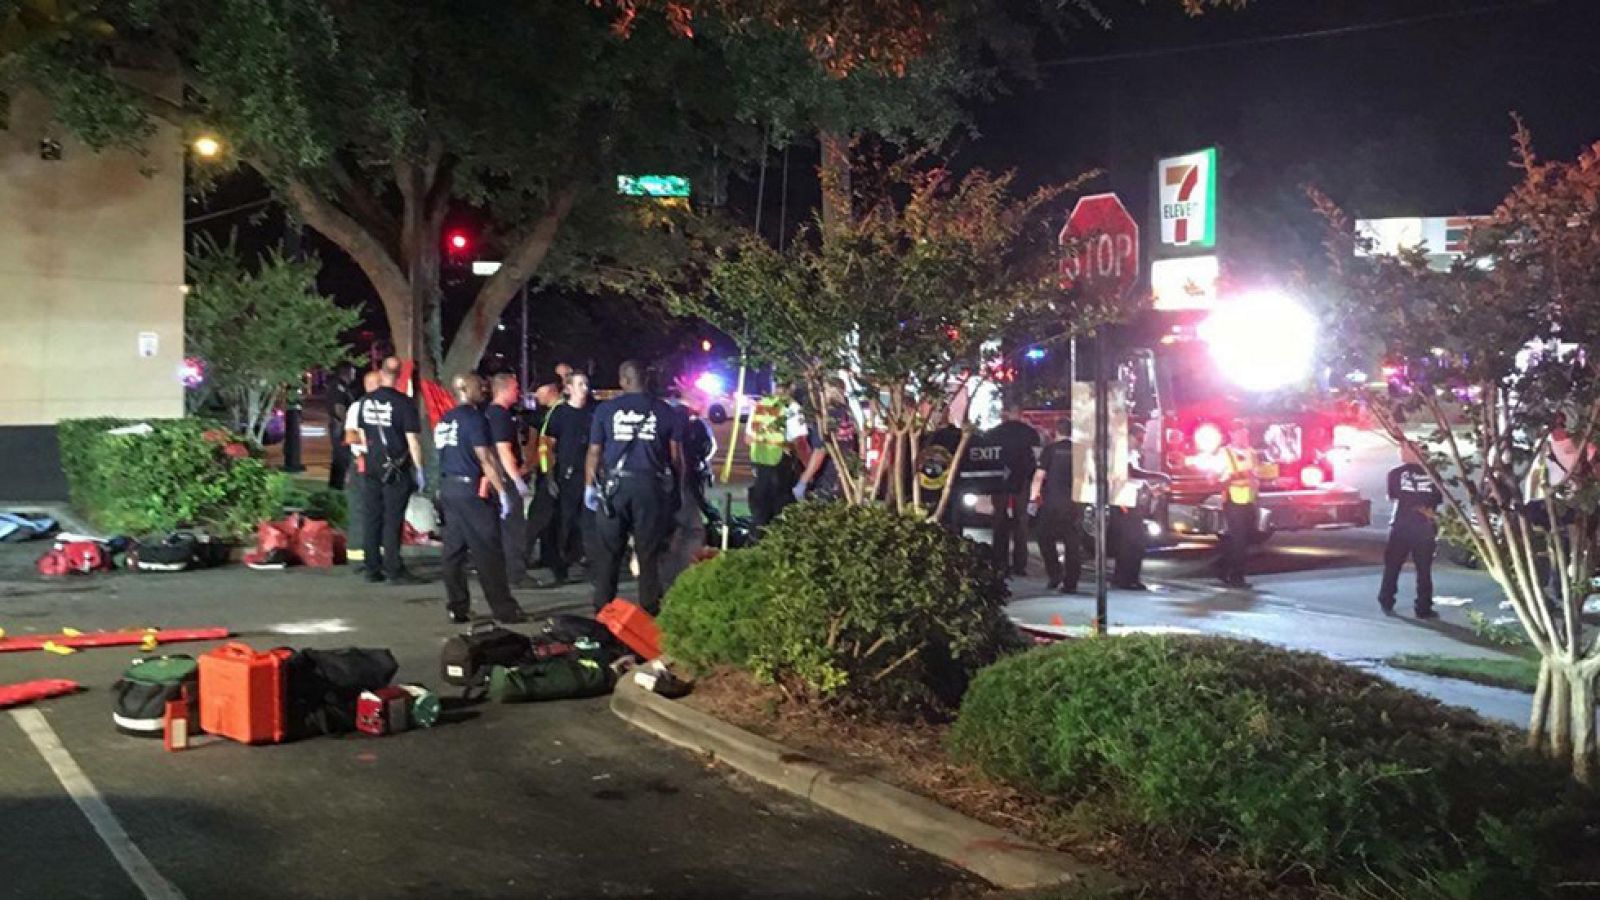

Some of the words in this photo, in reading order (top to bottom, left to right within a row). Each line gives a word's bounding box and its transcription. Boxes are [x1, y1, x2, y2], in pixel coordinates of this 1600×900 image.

[1163, 202, 1197, 220] ELEVE
[1165, 164, 1198, 242] 7
[1065, 234, 1132, 280] STOP
[969, 446, 1003, 460] EXIT
